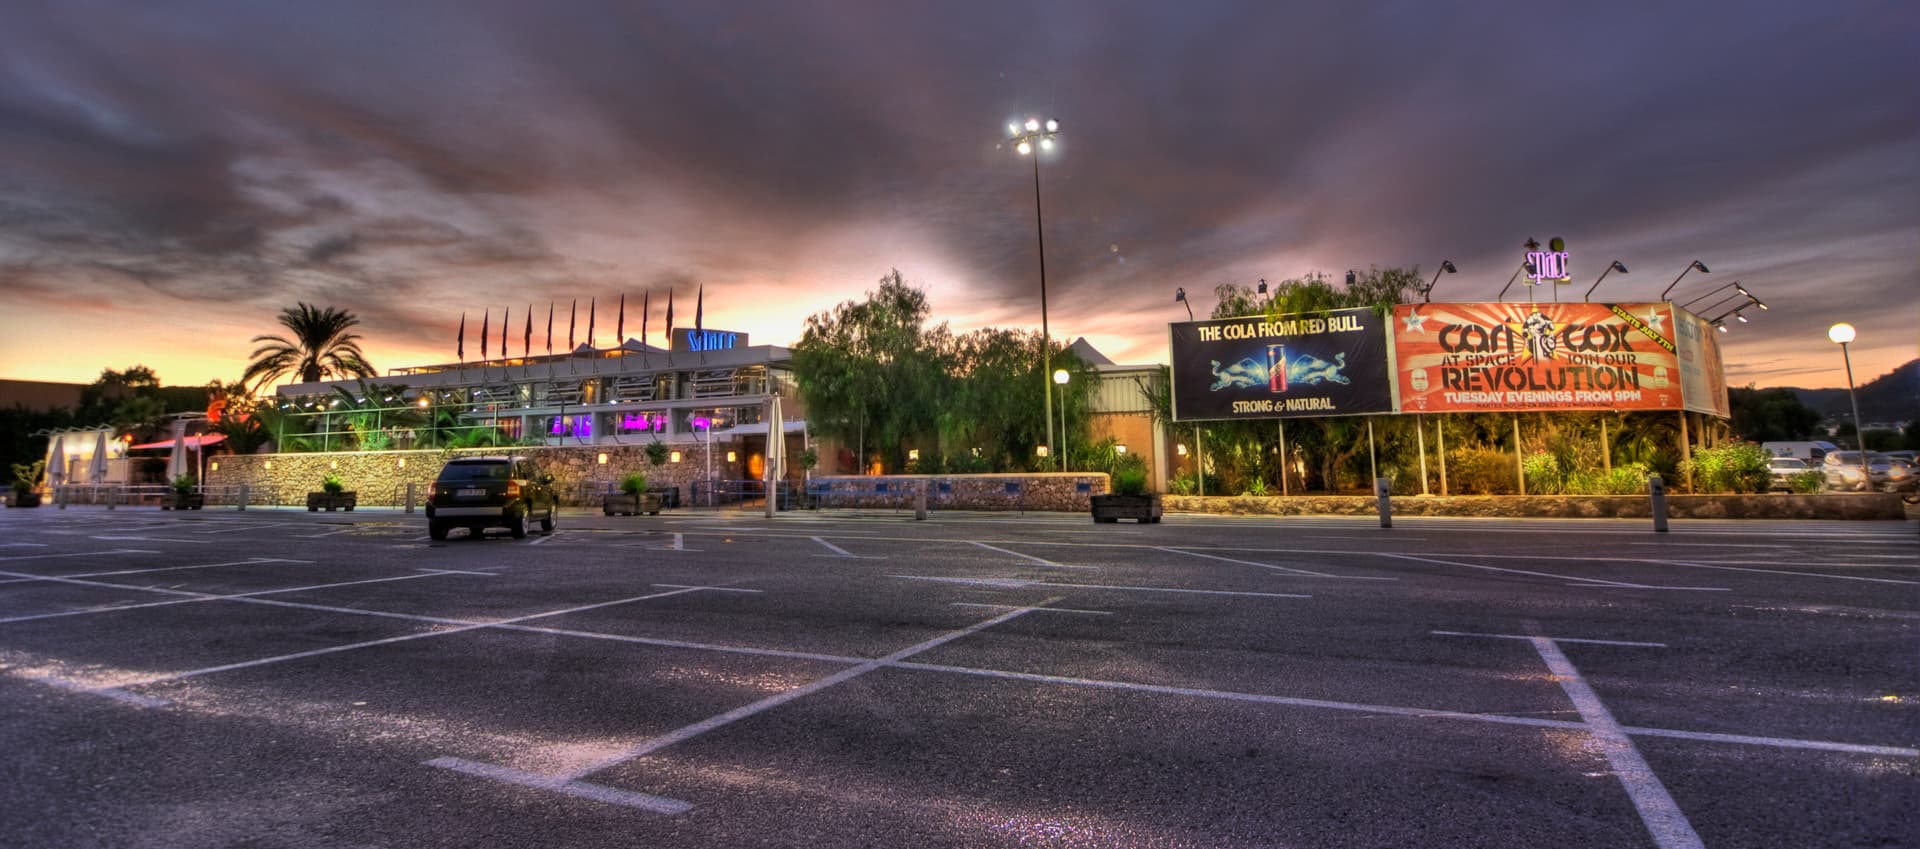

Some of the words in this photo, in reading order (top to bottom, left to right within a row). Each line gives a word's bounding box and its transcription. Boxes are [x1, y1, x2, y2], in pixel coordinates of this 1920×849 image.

[1199, 326, 1222, 342] THE
[1223, 323, 1257, 340] COLA
[1258, 320, 1298, 338] FROM
[1300, 319, 1326, 335] RED
[1612, 305, 1641, 329] STARTS
[1640, 326, 1659, 340] JULY
[1658, 337, 1674, 351] 7TH
[1442, 354, 1460, 366] AT
[1465, 354, 1516, 366] SPACE
[1567, 354, 1600, 365] JOIN
[1604, 354, 1637, 365] OUR
[1441, 366, 1640, 391] REVOLUTION
[1443, 391, 1504, 404] TUESDAY
[1506, 390, 1573, 403] EVENINGS
[1575, 390, 1613, 402] FROM
[1614, 390, 1642, 401] 9PM
[1232, 400, 1273, 413] STRONG
[1274, 401, 1285, 412] &
